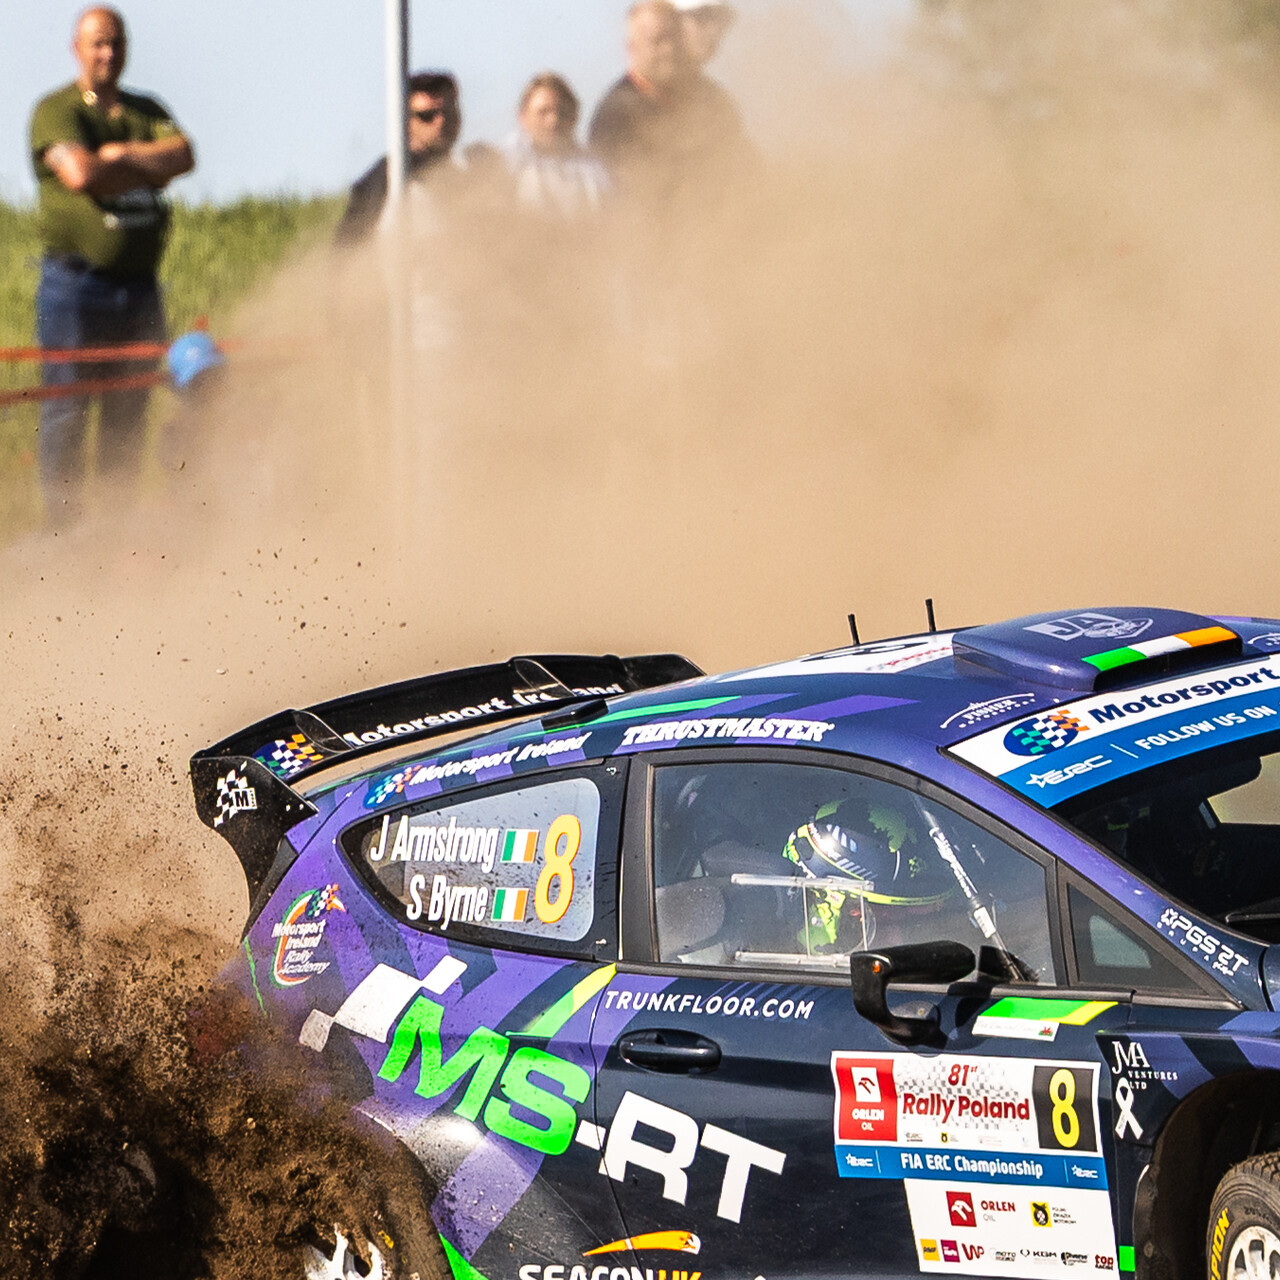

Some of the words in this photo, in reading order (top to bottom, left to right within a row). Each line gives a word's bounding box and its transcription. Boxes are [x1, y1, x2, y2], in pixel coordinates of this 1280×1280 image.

[512, 683, 625, 707] Ireand
[1087, 664, 1280, 725] Motorsport
[621, 717, 832, 746] THRUSTMASTER
[1134, 719, 1217, 751] FOLLOW
[1212, 712, 1247, 729] US
[1246, 704, 1278, 720] ON
[408, 746, 520, 787] Motorsport
[515, 731, 593, 763] Ireland
[370, 814, 391, 862] J
[390, 814, 500, 874] Armstrong
[534, 813, 582, 924] 8
[406, 873, 426, 921] S
[426, 873, 490, 931] Byrne
[271, 918, 327, 938] Motorsport
[1170, 914, 1221, 955] PGS
[604, 990, 815, 1020] TRUNKFLOOR.COM
[1127, 1070, 1179, 1081] VENTURES
[1129, 1081, 1148, 1090] LTD
[376, 996, 788, 1225] MS-RT
[851, 1107, 885, 1121] ORLEN
[902, 1092, 955, 1124] Rally
[958, 1099, 1031, 1121] Poland
[1048, 1068, 1080, 1149] 8
[861, 1121, 875, 1132] OIL
[900, 1152, 922, 1170] FIA
[926, 1155, 952, 1172] ERC
[954, 1156, 1044, 1180] Championship
[980, 1200, 1017, 1213] ORLEN
[982, 1213, 997, 1222] OIL
